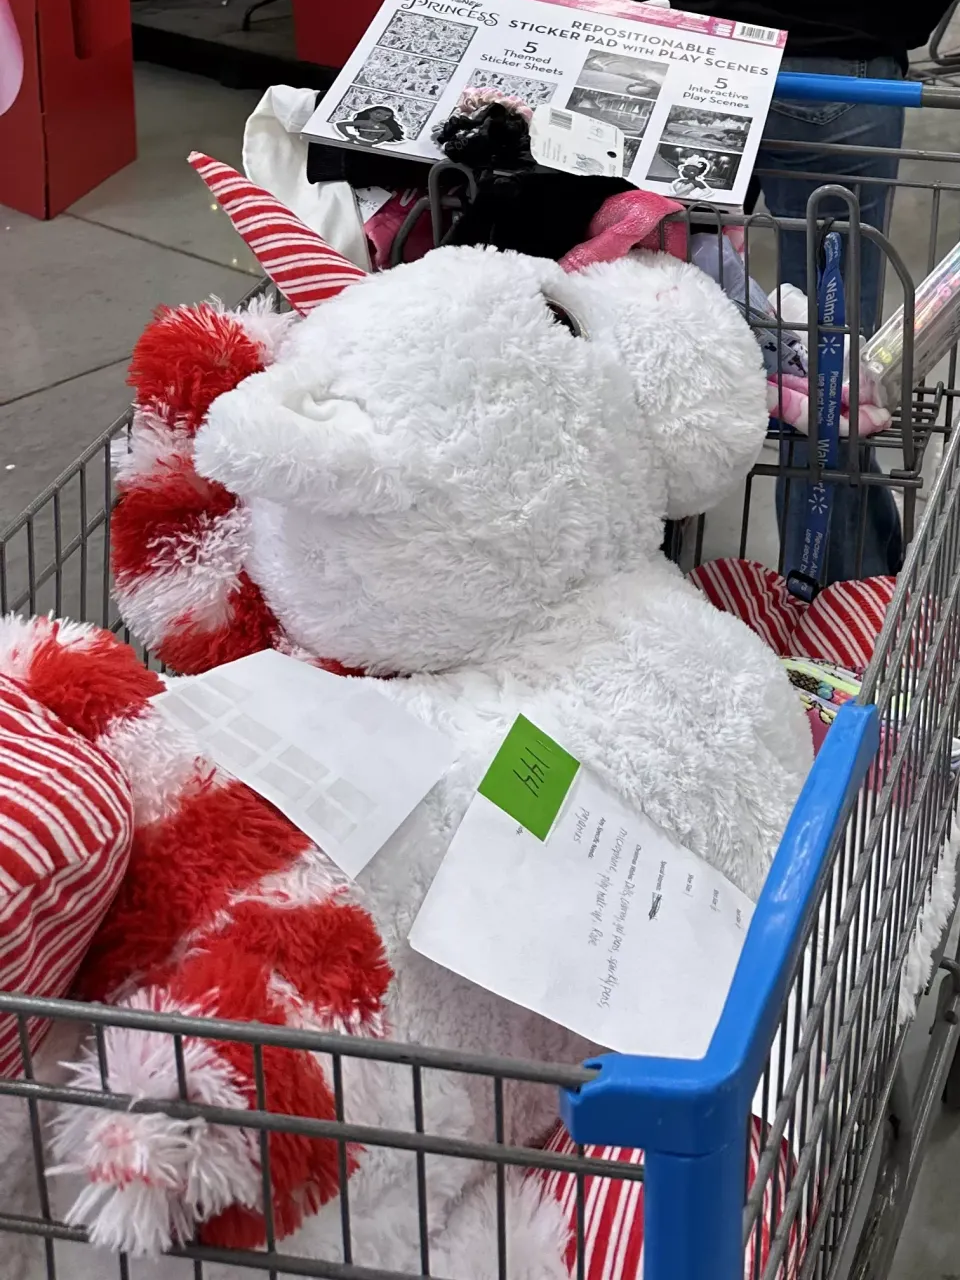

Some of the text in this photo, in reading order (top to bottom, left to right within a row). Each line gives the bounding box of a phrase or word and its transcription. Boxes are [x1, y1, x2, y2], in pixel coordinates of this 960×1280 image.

[508, 19, 769, 76] STICKER PAD WITH PLAY SCENES
[522, 40, 539, 54] 5
[570, 19, 717, 57] REPOSITIONABLE
[479, 53, 564, 76] Sticker Sheets
[503, 48, 552, 65] Themed
[688, 83, 749, 101] Interactive
[714, 77, 729, 90] 5
[682, 91, 751, 109] Play Scenes
[826, 370, 839, 427] Please: Always
[512, 746, 550, 798] 144
